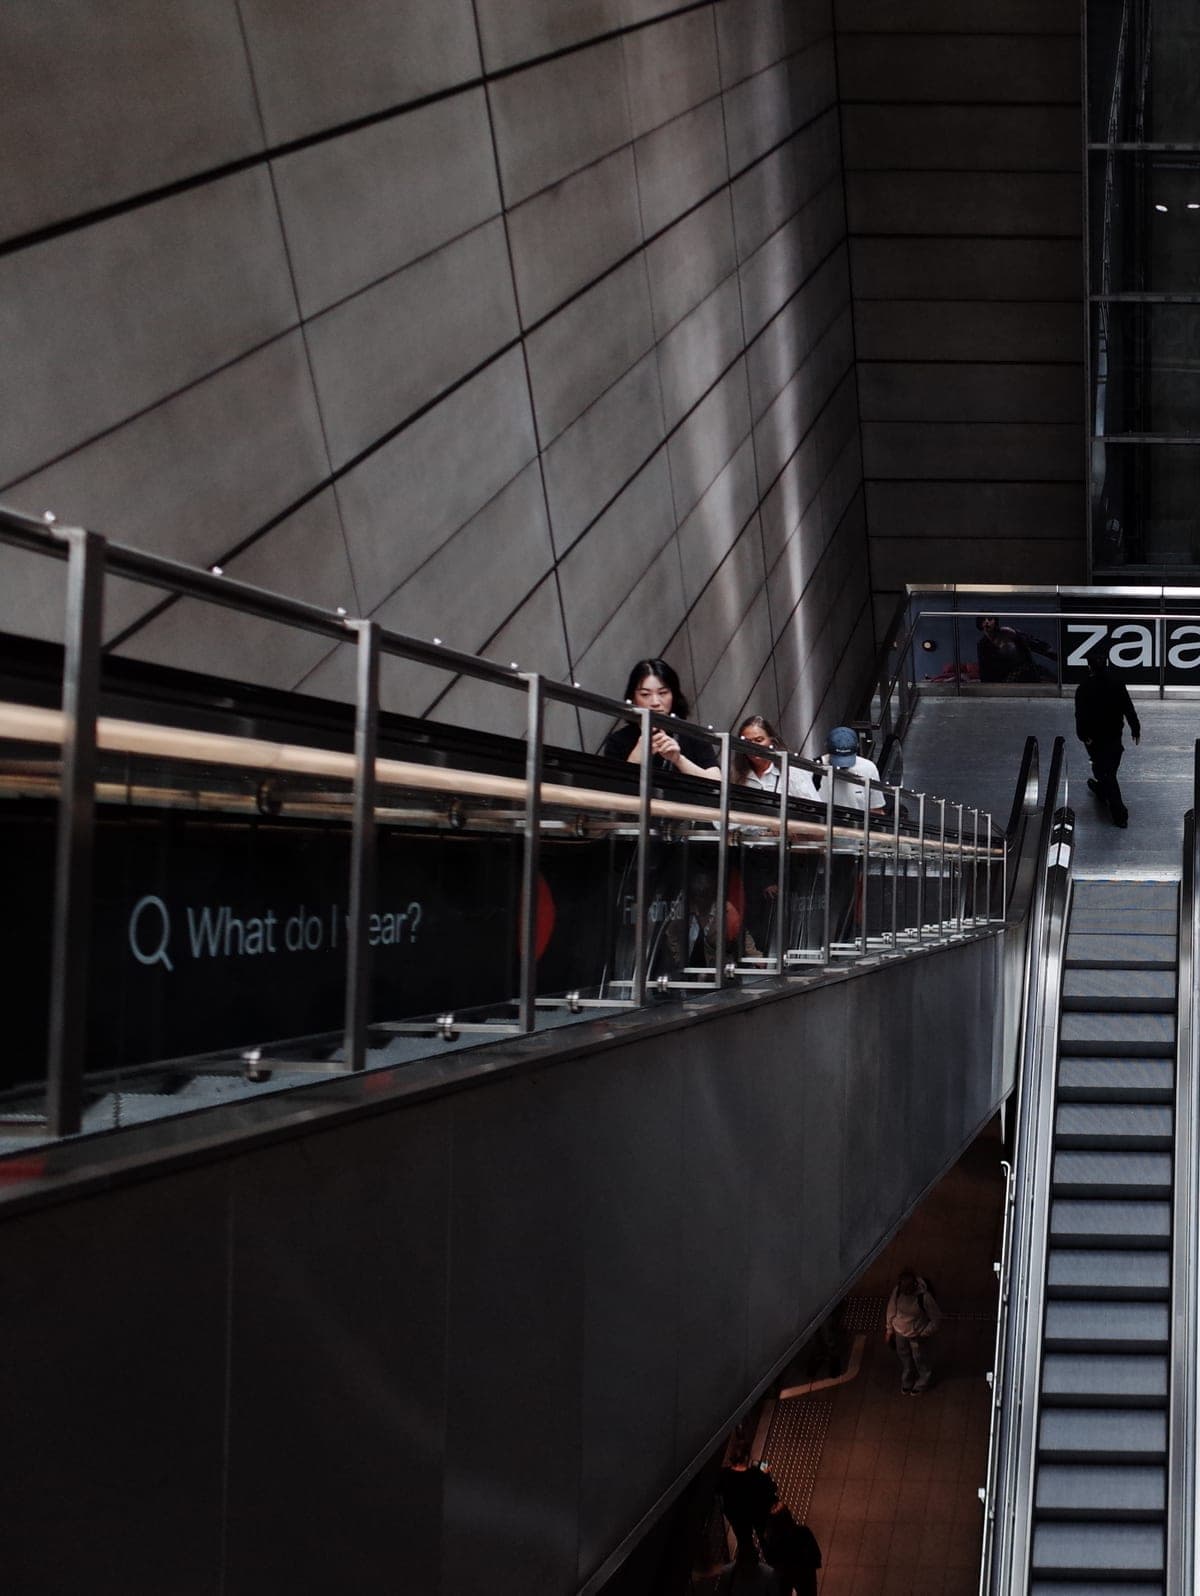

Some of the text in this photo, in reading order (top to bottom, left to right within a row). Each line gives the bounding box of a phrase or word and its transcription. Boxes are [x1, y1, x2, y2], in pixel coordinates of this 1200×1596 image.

[187, 905, 277, 959] What
[285, 903, 322, 952] do
[345, 901, 422, 947] ear?
